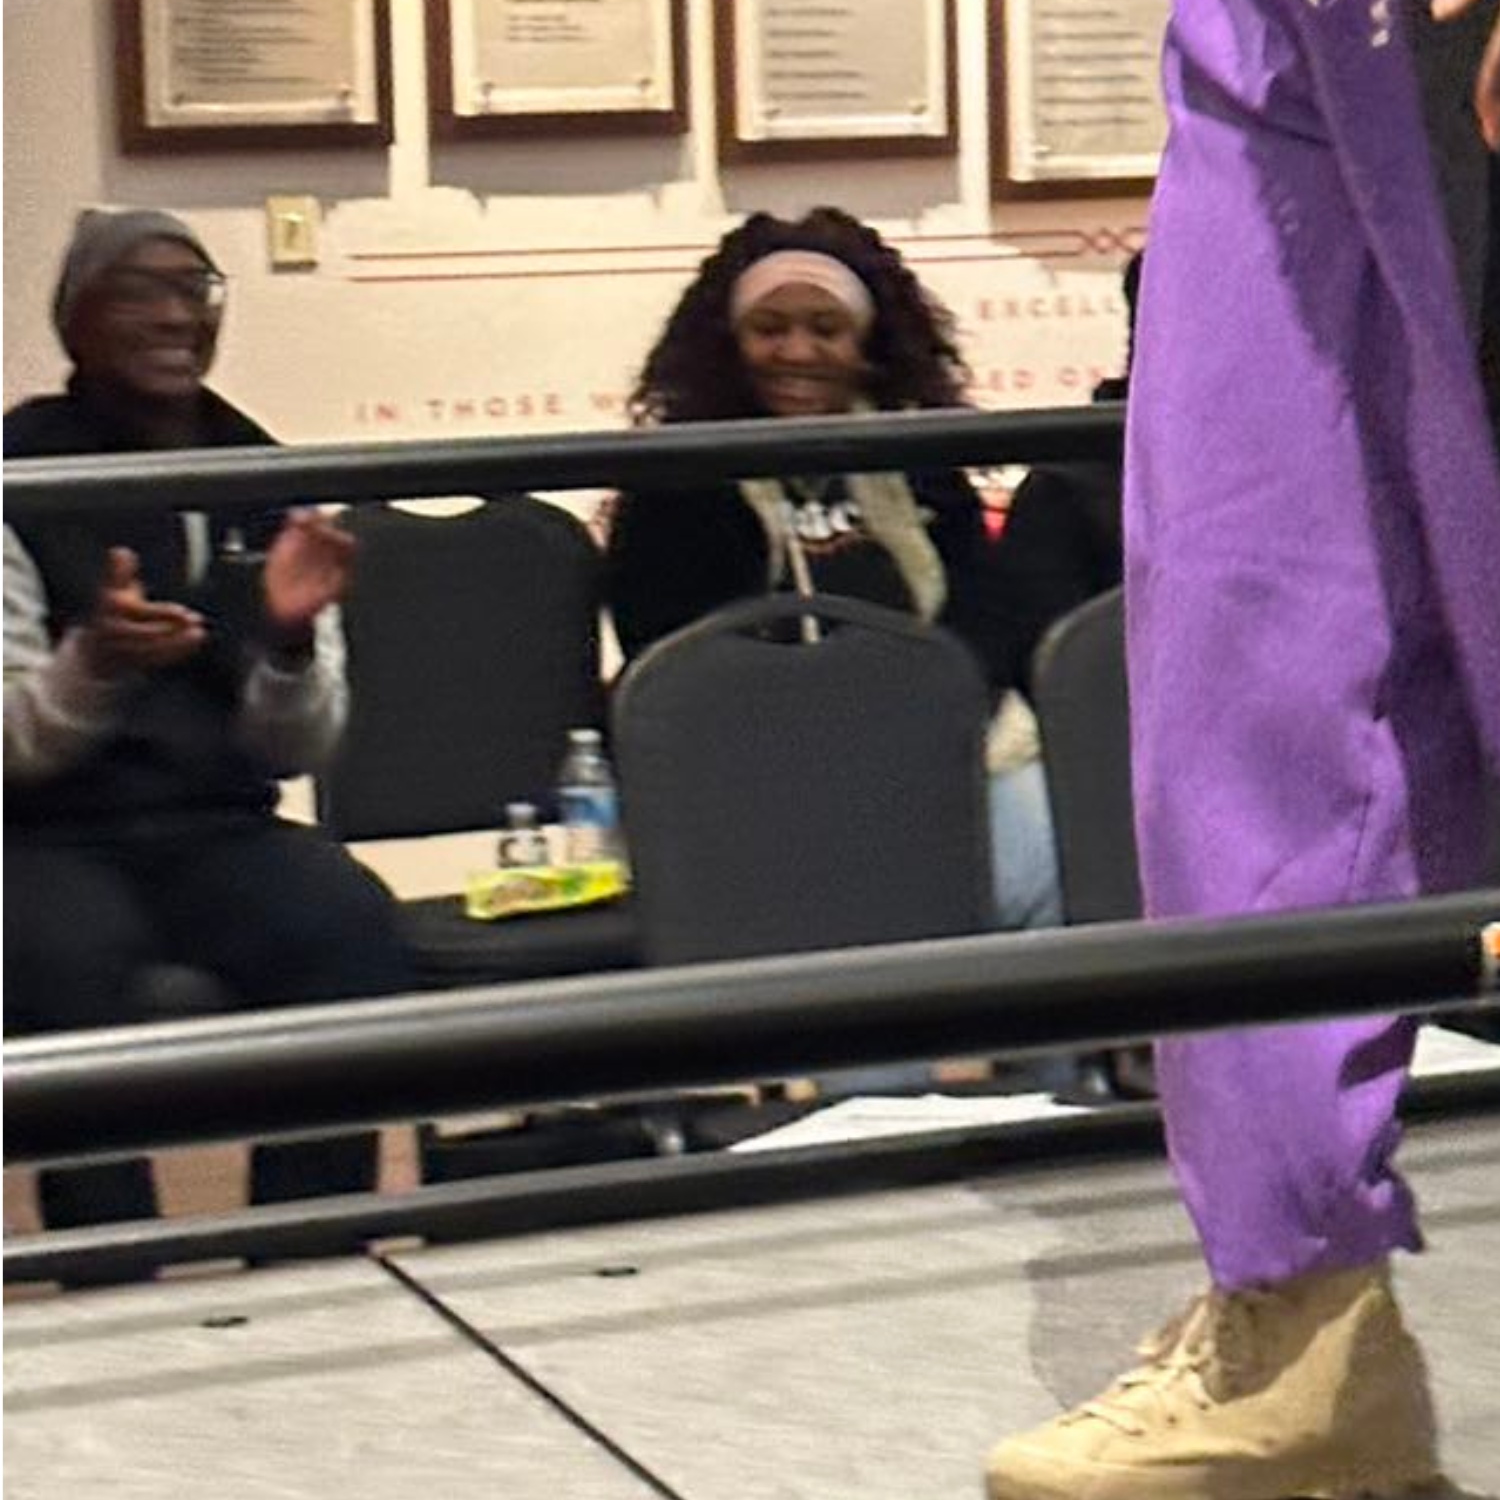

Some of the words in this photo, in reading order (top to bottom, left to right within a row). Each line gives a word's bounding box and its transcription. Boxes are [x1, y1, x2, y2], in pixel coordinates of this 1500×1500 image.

[977, 294, 1121, 322] EXCELL
[354, 401, 398, 423] IN
[427, 393, 565, 420] THOSE
